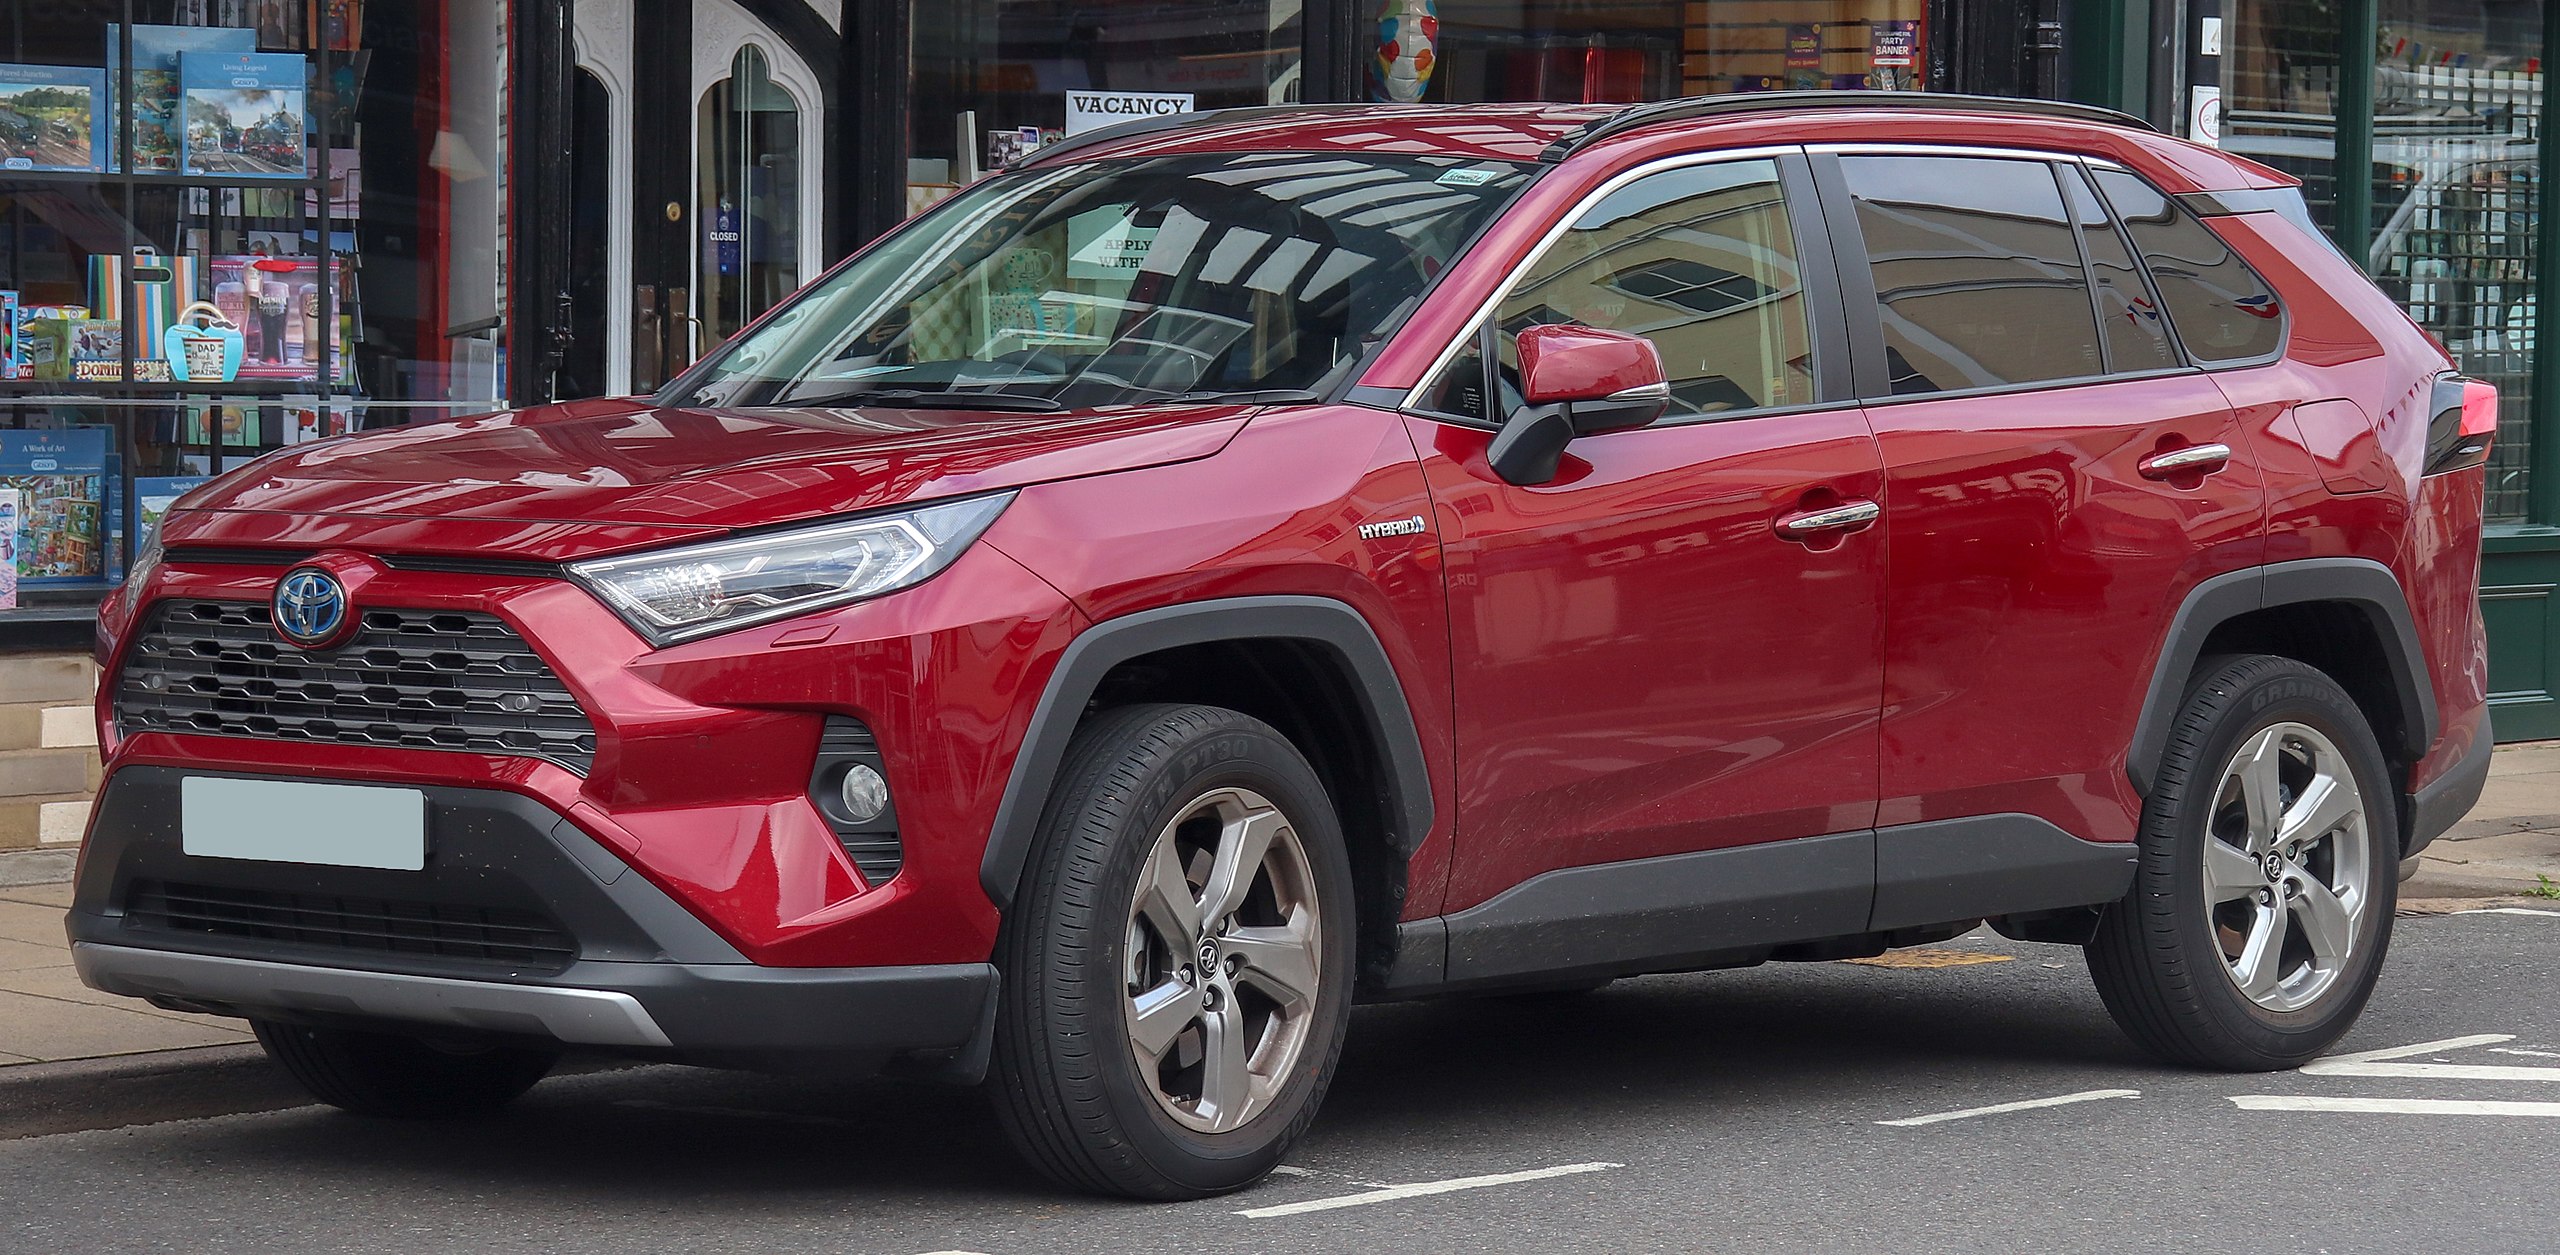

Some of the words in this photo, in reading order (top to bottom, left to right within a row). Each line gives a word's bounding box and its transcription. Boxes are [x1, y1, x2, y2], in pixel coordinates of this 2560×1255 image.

[1881, 37, 1905, 45] PARTY
[1875, 45, 1909, 55] BANNER
[222, 64, 243, 72] Living
[244, 64, 267, 72] Legend
[21, 70, 52, 78] Junction
[1073, 96, 1186, 115] VACANCY
[709, 231, 738, 241] CLOSED
[1104, 240, 1152, 250] APPLY
[1098, 256, 1144, 268] WITH
[197, 343, 216, 353] DAD
[22, 445, 29, 453] A
[29, 445, 47, 453] Work
[47, 445, 54, 453] of
[54, 445, 66, 453] Art
[1359, 519, 1415, 539] HYBRID
